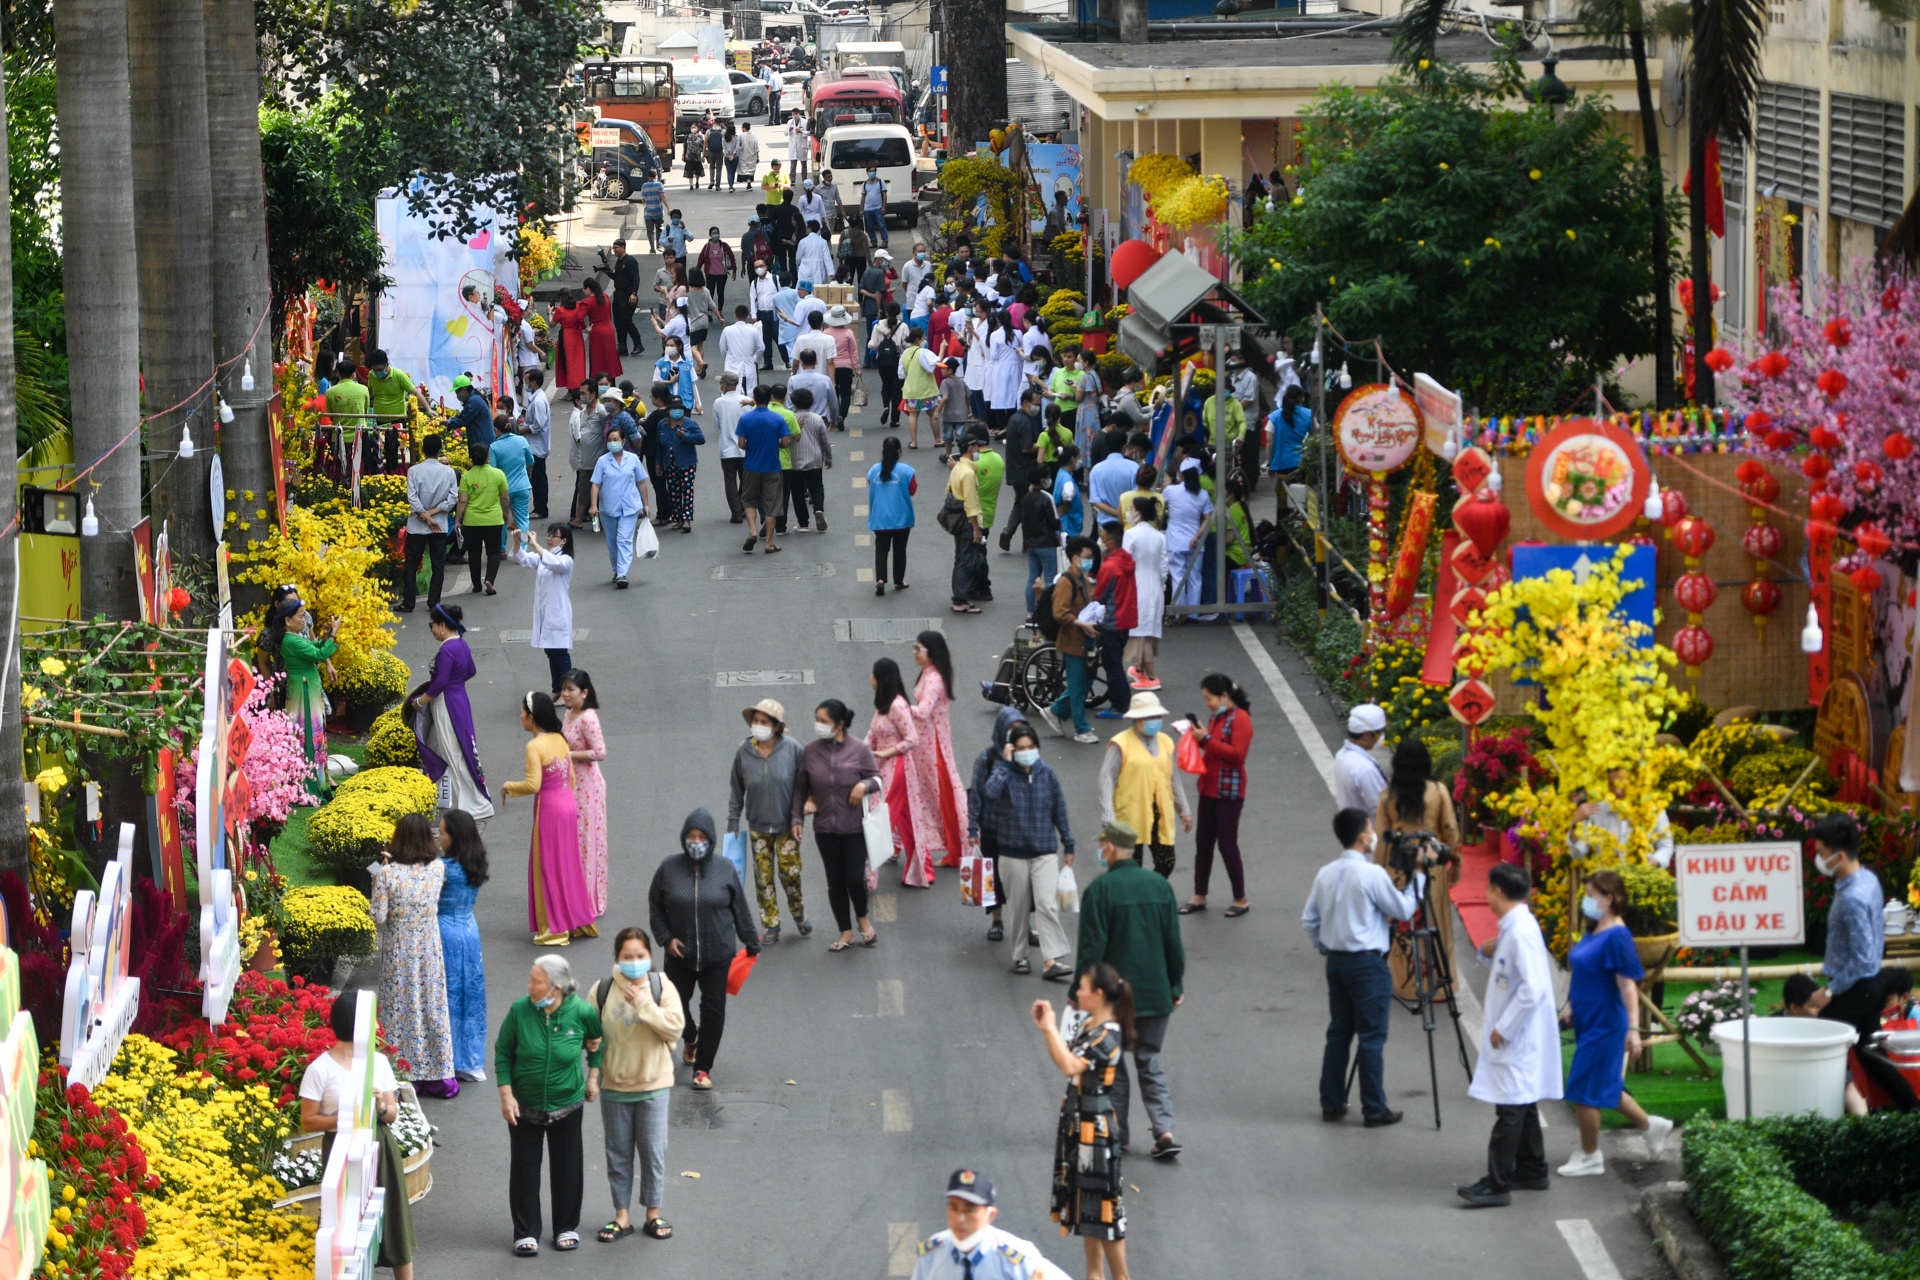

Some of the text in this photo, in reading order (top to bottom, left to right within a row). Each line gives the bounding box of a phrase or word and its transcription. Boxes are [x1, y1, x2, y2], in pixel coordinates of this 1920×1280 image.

[1687, 854, 1791, 876] KHU VỰC
[1713, 879, 1768, 902] CẤM
[1697, 911, 1785, 935] ĐẬU XE
